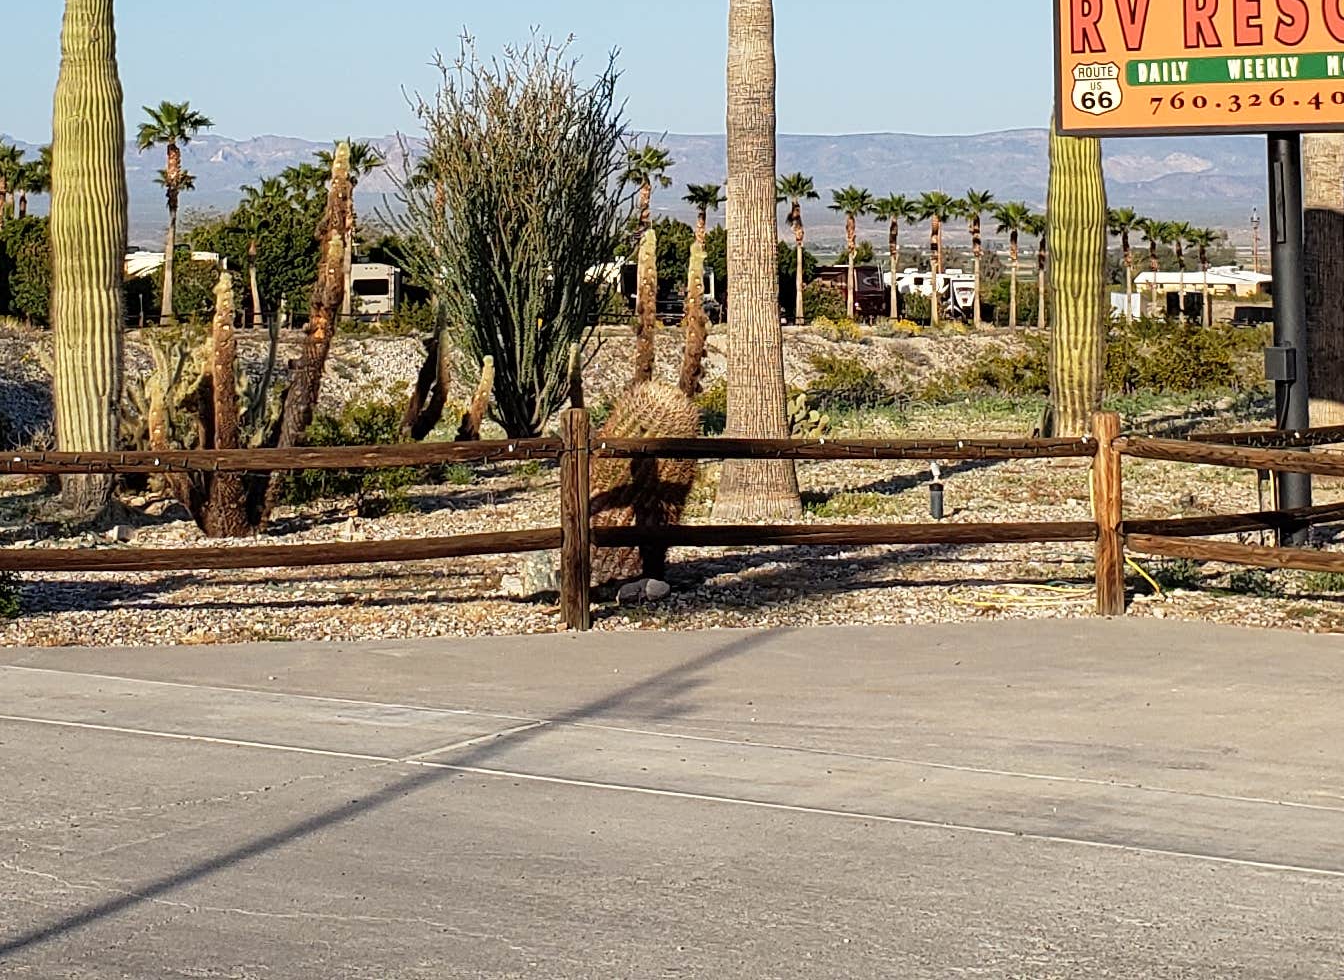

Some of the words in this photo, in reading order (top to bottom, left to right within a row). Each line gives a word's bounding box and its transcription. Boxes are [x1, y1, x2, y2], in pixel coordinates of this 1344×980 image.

[1078, 66, 1113, 78] ROUTE
[1137, 61, 1189, 83] DAILY
[1227, 56, 1299, 80] WEEKLY
[1090, 81, 1102, 90] US
[1081, 91, 1113, 109] 66
